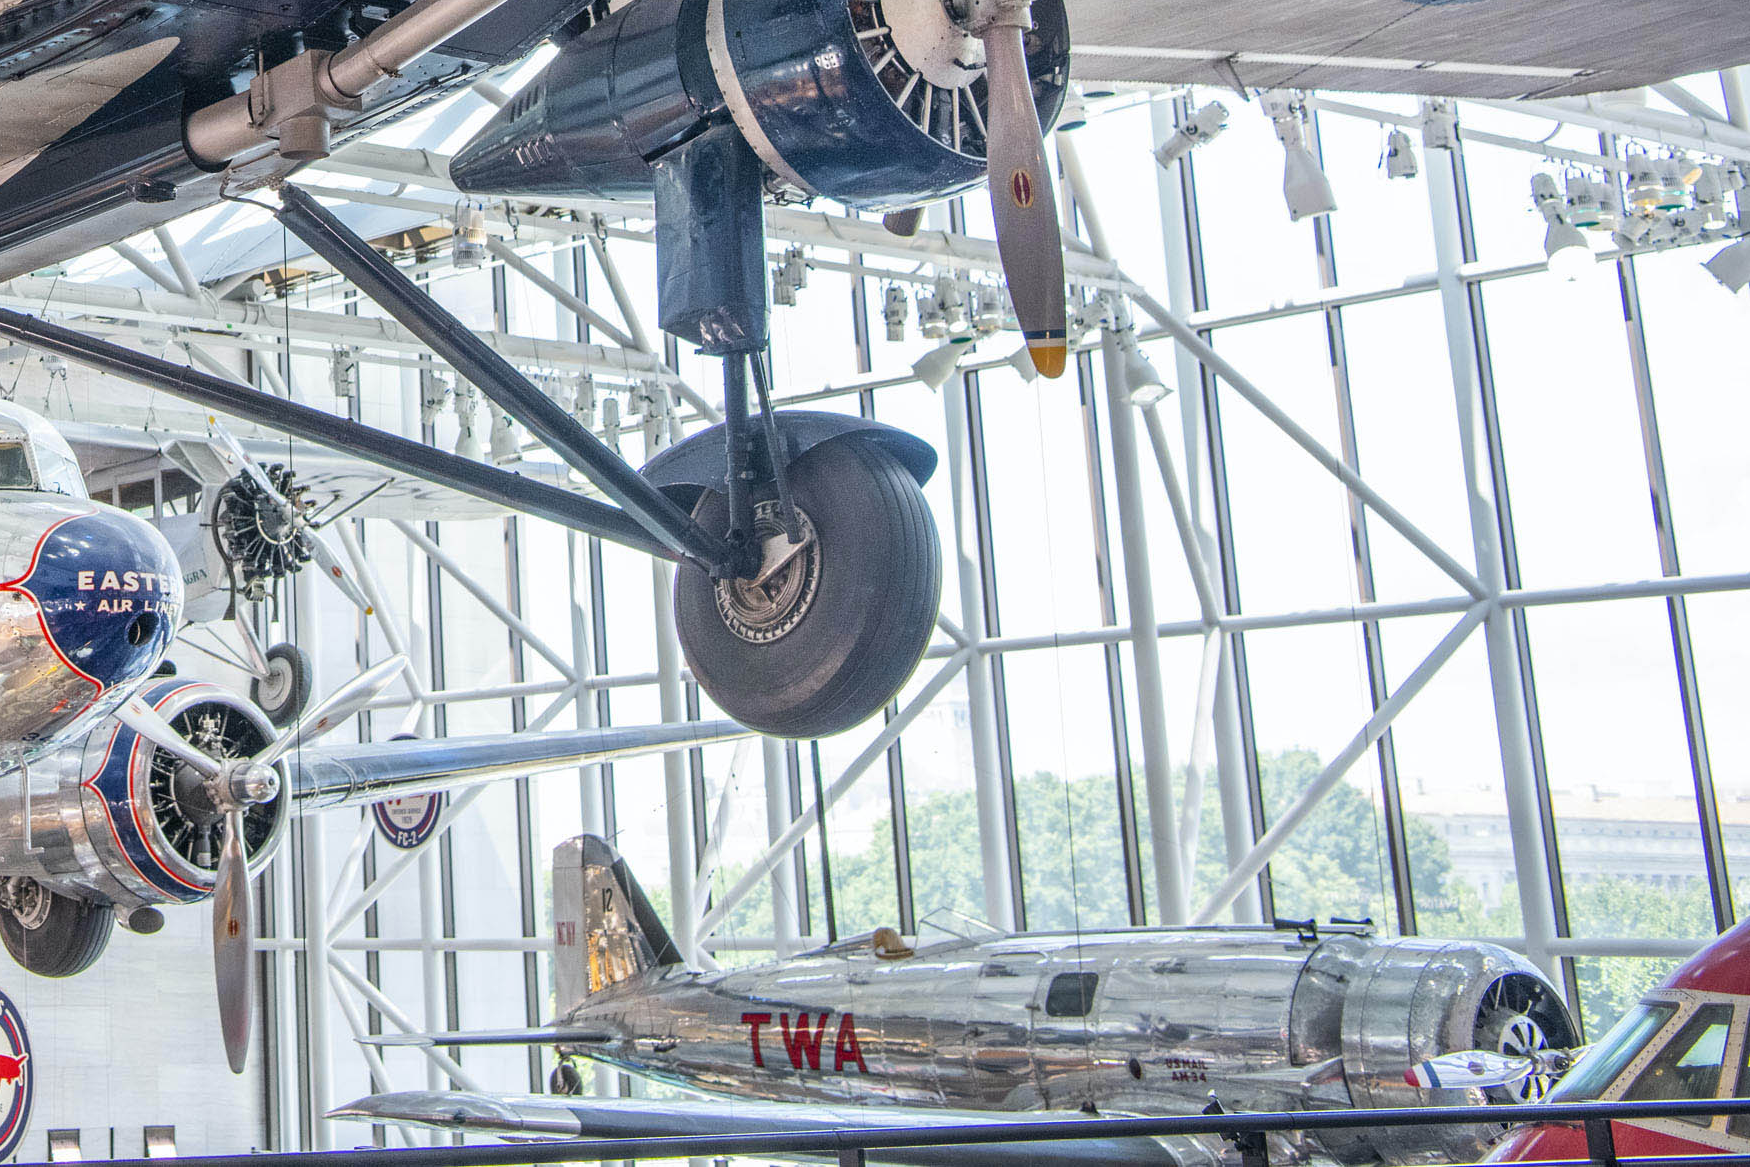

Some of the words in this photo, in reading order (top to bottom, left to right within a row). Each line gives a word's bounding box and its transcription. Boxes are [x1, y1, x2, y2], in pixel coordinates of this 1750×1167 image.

[98, 600, 132, 612] AIR
[397, 830, 418, 846] FC-2
[602, 888, 613, 912] 12
[741, 1012, 869, 1074] TWA
[1182, 1058, 1208, 1070] MAIL
